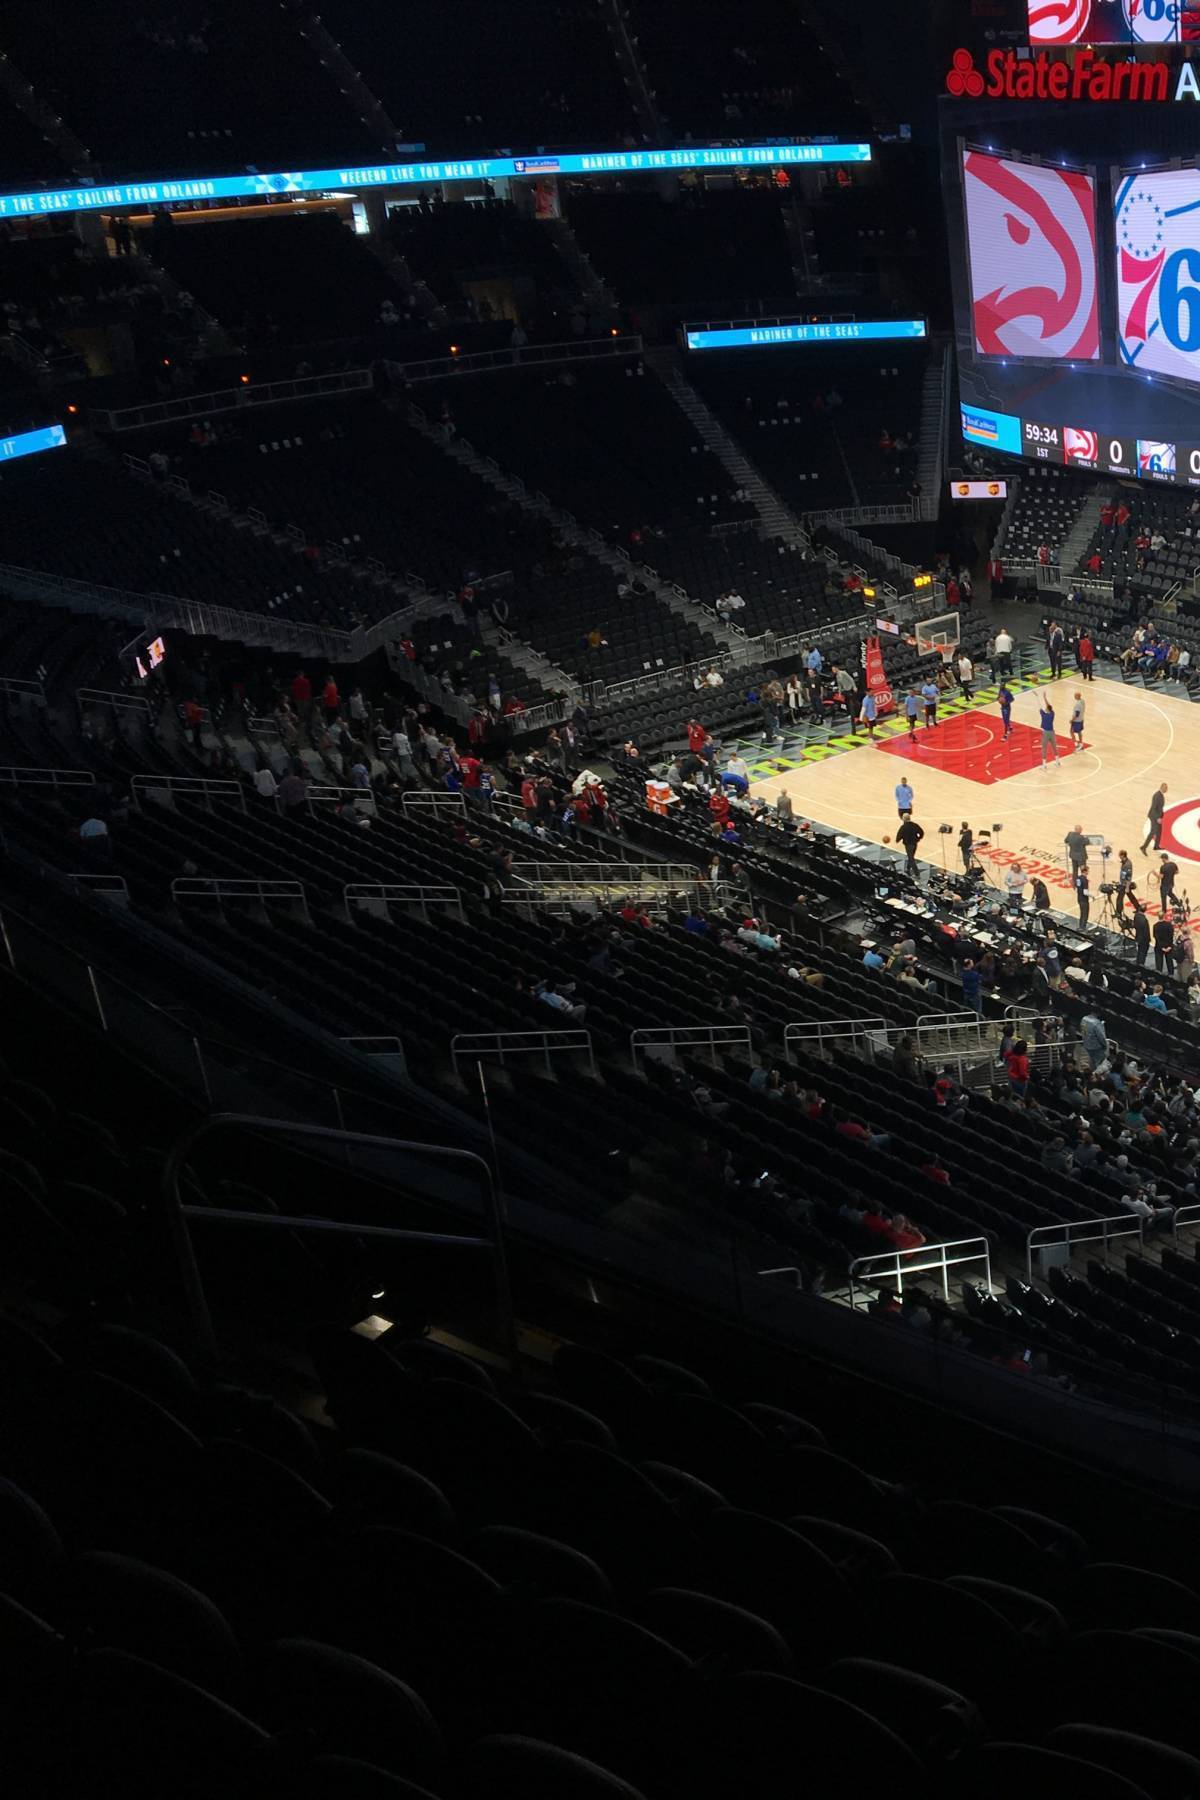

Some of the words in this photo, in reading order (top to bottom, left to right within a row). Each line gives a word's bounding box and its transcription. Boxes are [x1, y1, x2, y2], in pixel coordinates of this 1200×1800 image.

[581, 154, 628, 169] MARINER
[631, 154, 643, 167] OF
[648, 153, 667, 166] THE
[703, 150, 744, 164] SAILING
[749, 148, 774, 162] FROM
[778, 146, 824, 160] ORLANDO
[339, 168, 388, 185] WEEKEND
[392, 166, 415, 181] LIKE
[419, 165, 440, 179] YOU
[444, 163, 474, 177] MEAN
[12, 197, 36, 212] THE
[77, 189, 122, 206] SAILING
[126, 185, 158, 201] FROM
[162, 181, 215, 199] ORLANDO
[751, 328, 792, 342] MARINER
[797, 327, 808, 338] OF
[814, 326, 831, 337] THE
[1025, 423, 1059, 445] 59:34
[1036, 447, 1049, 458] 1ST
[1110, 440, 1123, 464] 0
